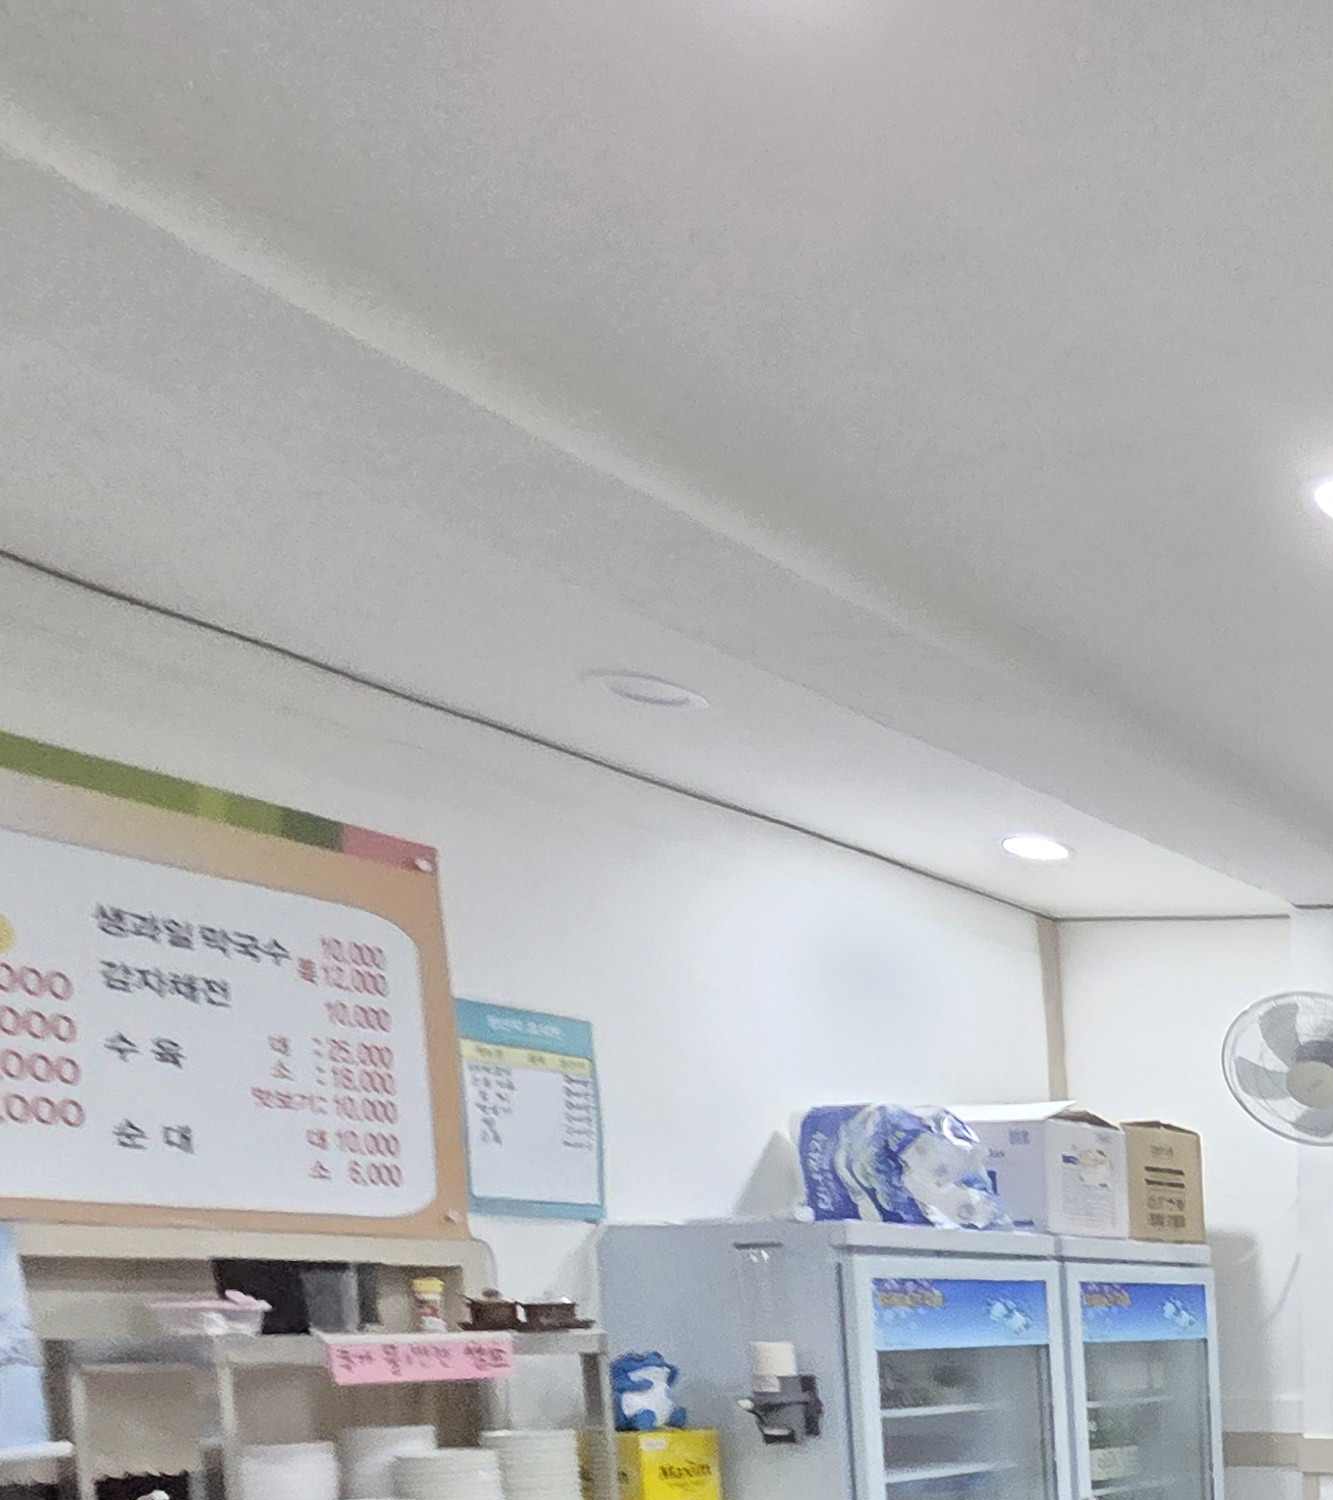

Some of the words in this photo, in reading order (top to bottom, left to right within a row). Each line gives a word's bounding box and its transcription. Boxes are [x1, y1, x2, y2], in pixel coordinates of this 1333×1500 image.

[94, 902, 195, 951] 생과일
[199, 924, 292, 966] 막국수
[320, 936, 386, 971] 10,000
[99, 959, 232, 1008] 감자채전
[325, 1000, 392, 1033] 10,000
[321, 964, 390, 998] 12,000
[335, 1129, 401, 1159] 10,000
